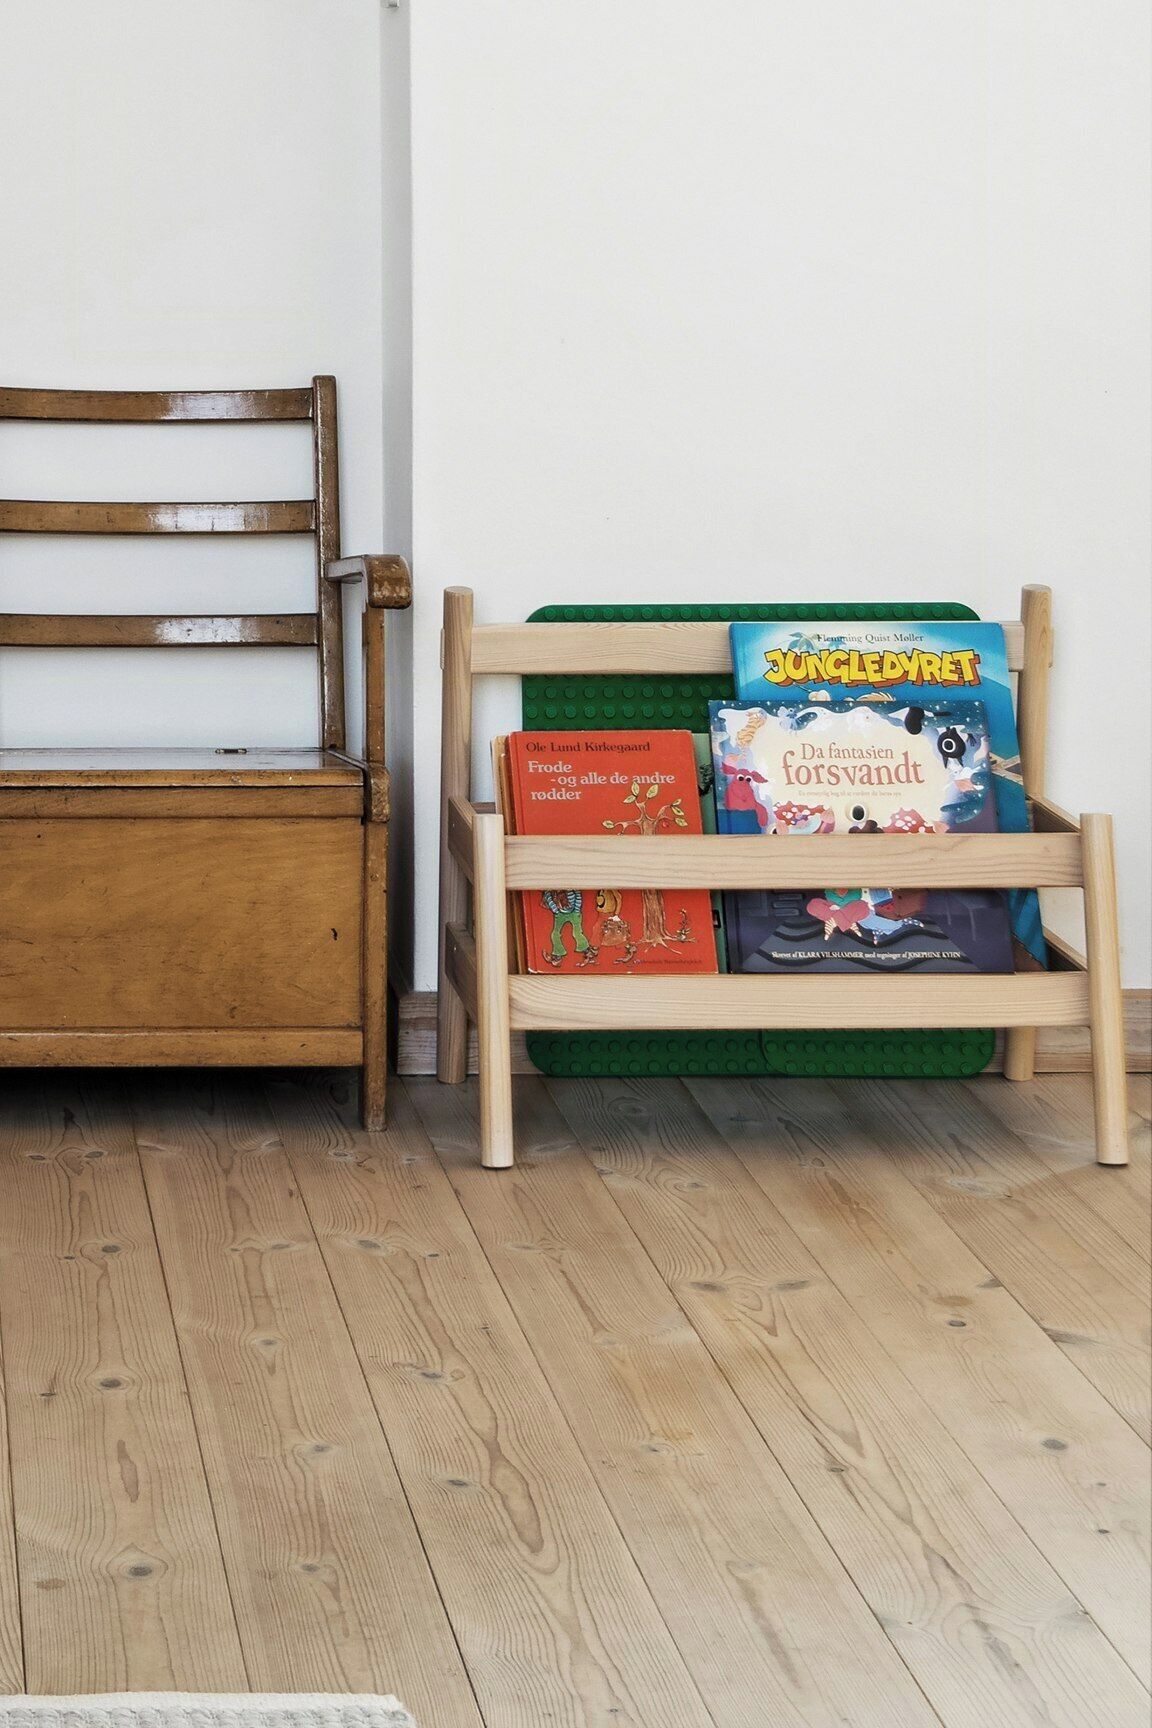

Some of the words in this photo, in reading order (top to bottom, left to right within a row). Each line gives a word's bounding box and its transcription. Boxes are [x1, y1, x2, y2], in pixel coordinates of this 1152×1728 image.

[817, 633, 862, 643] Flemming
[865, 633, 890, 643] Quist
[894, 633, 924, 642] Møller
[763, 648, 981, 688] JUNGLEDYRET
[525, 742, 546, 753] Ole
[551, 742, 580, 752] Lund
[585, 741, 651, 754] Kirkegaard
[801, 743, 824, 760] Da
[828, 742, 894, 760] fantasien
[527, 761, 572, 773] Frode
[781, 750, 925, 786] forsvandt
[580, 773, 607, 785] alle
[610, 772, 628, 784] de
[632, 772, 676, 784] andre
[531, 788, 581, 801] rødder
